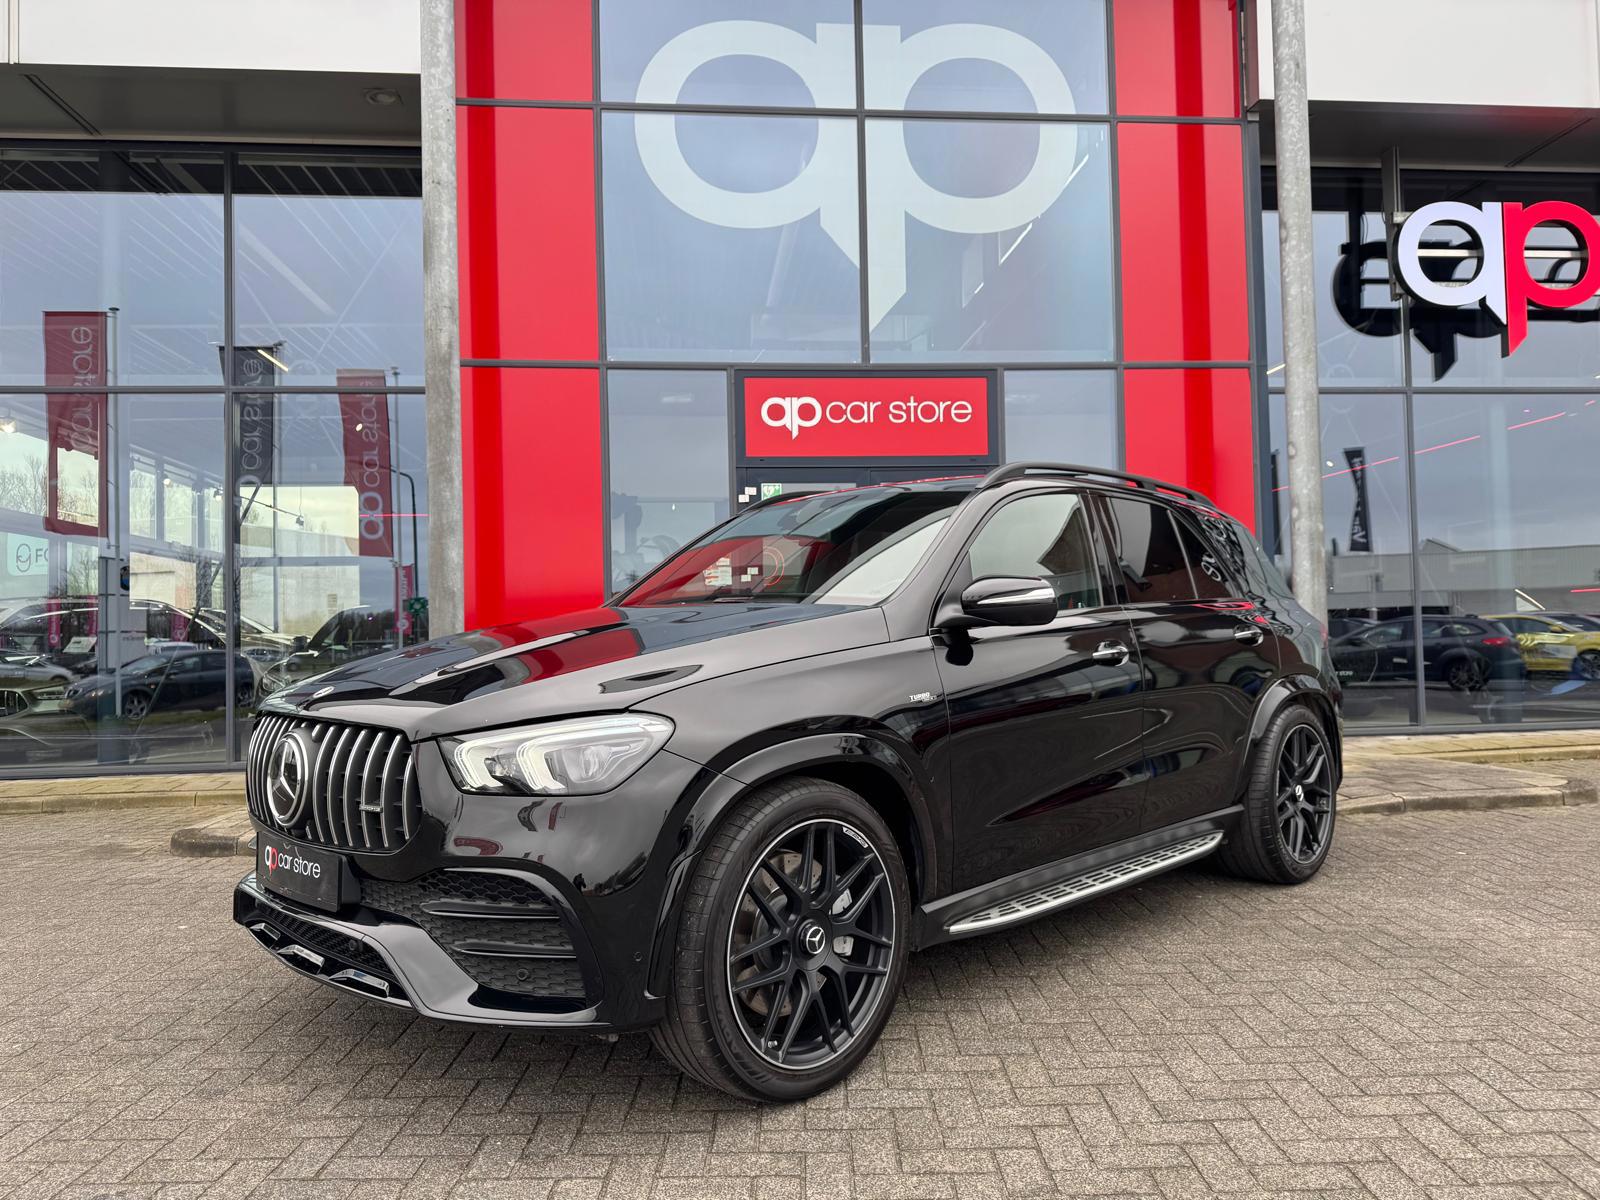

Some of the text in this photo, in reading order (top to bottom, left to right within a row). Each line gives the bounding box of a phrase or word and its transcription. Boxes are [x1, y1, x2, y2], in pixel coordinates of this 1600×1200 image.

[634, 20, 1077, 334] ap
[1398, 201, 1600, 356] ap
[760, 395, 973, 441] ap car store
[264, 845, 321, 879] ap car store
